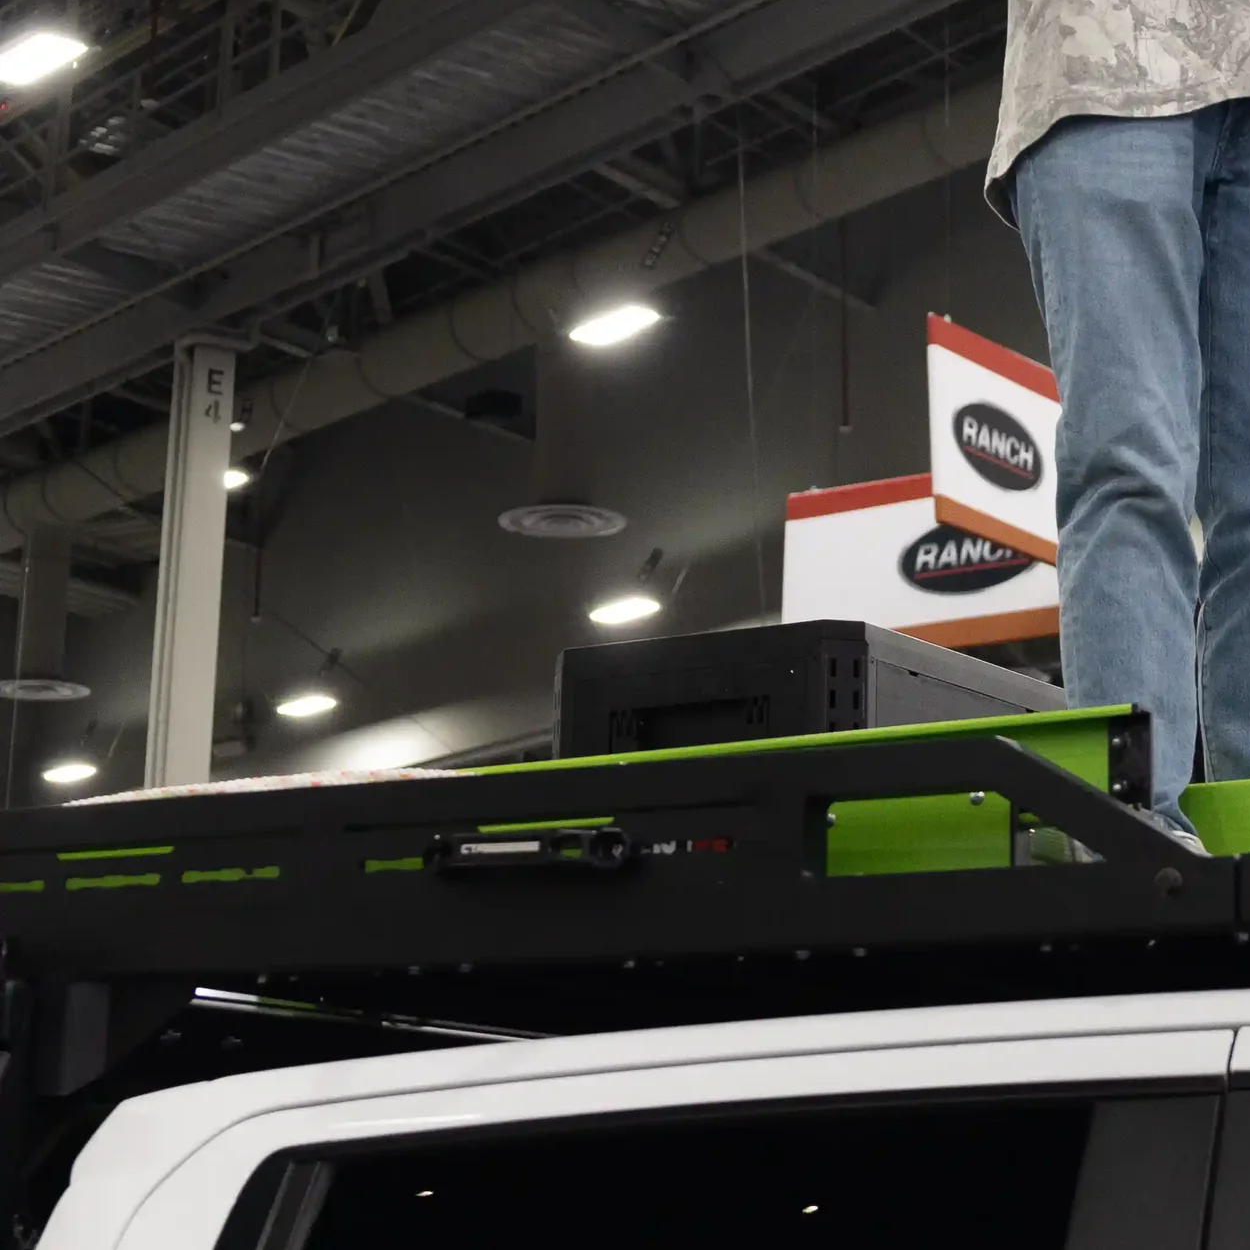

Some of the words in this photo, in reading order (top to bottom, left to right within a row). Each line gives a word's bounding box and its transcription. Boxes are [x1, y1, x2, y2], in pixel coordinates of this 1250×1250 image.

[206, 367, 225, 396] E
[961, 415, 1036, 472] RANCH
[914, 537, 1014, 573] RANC
